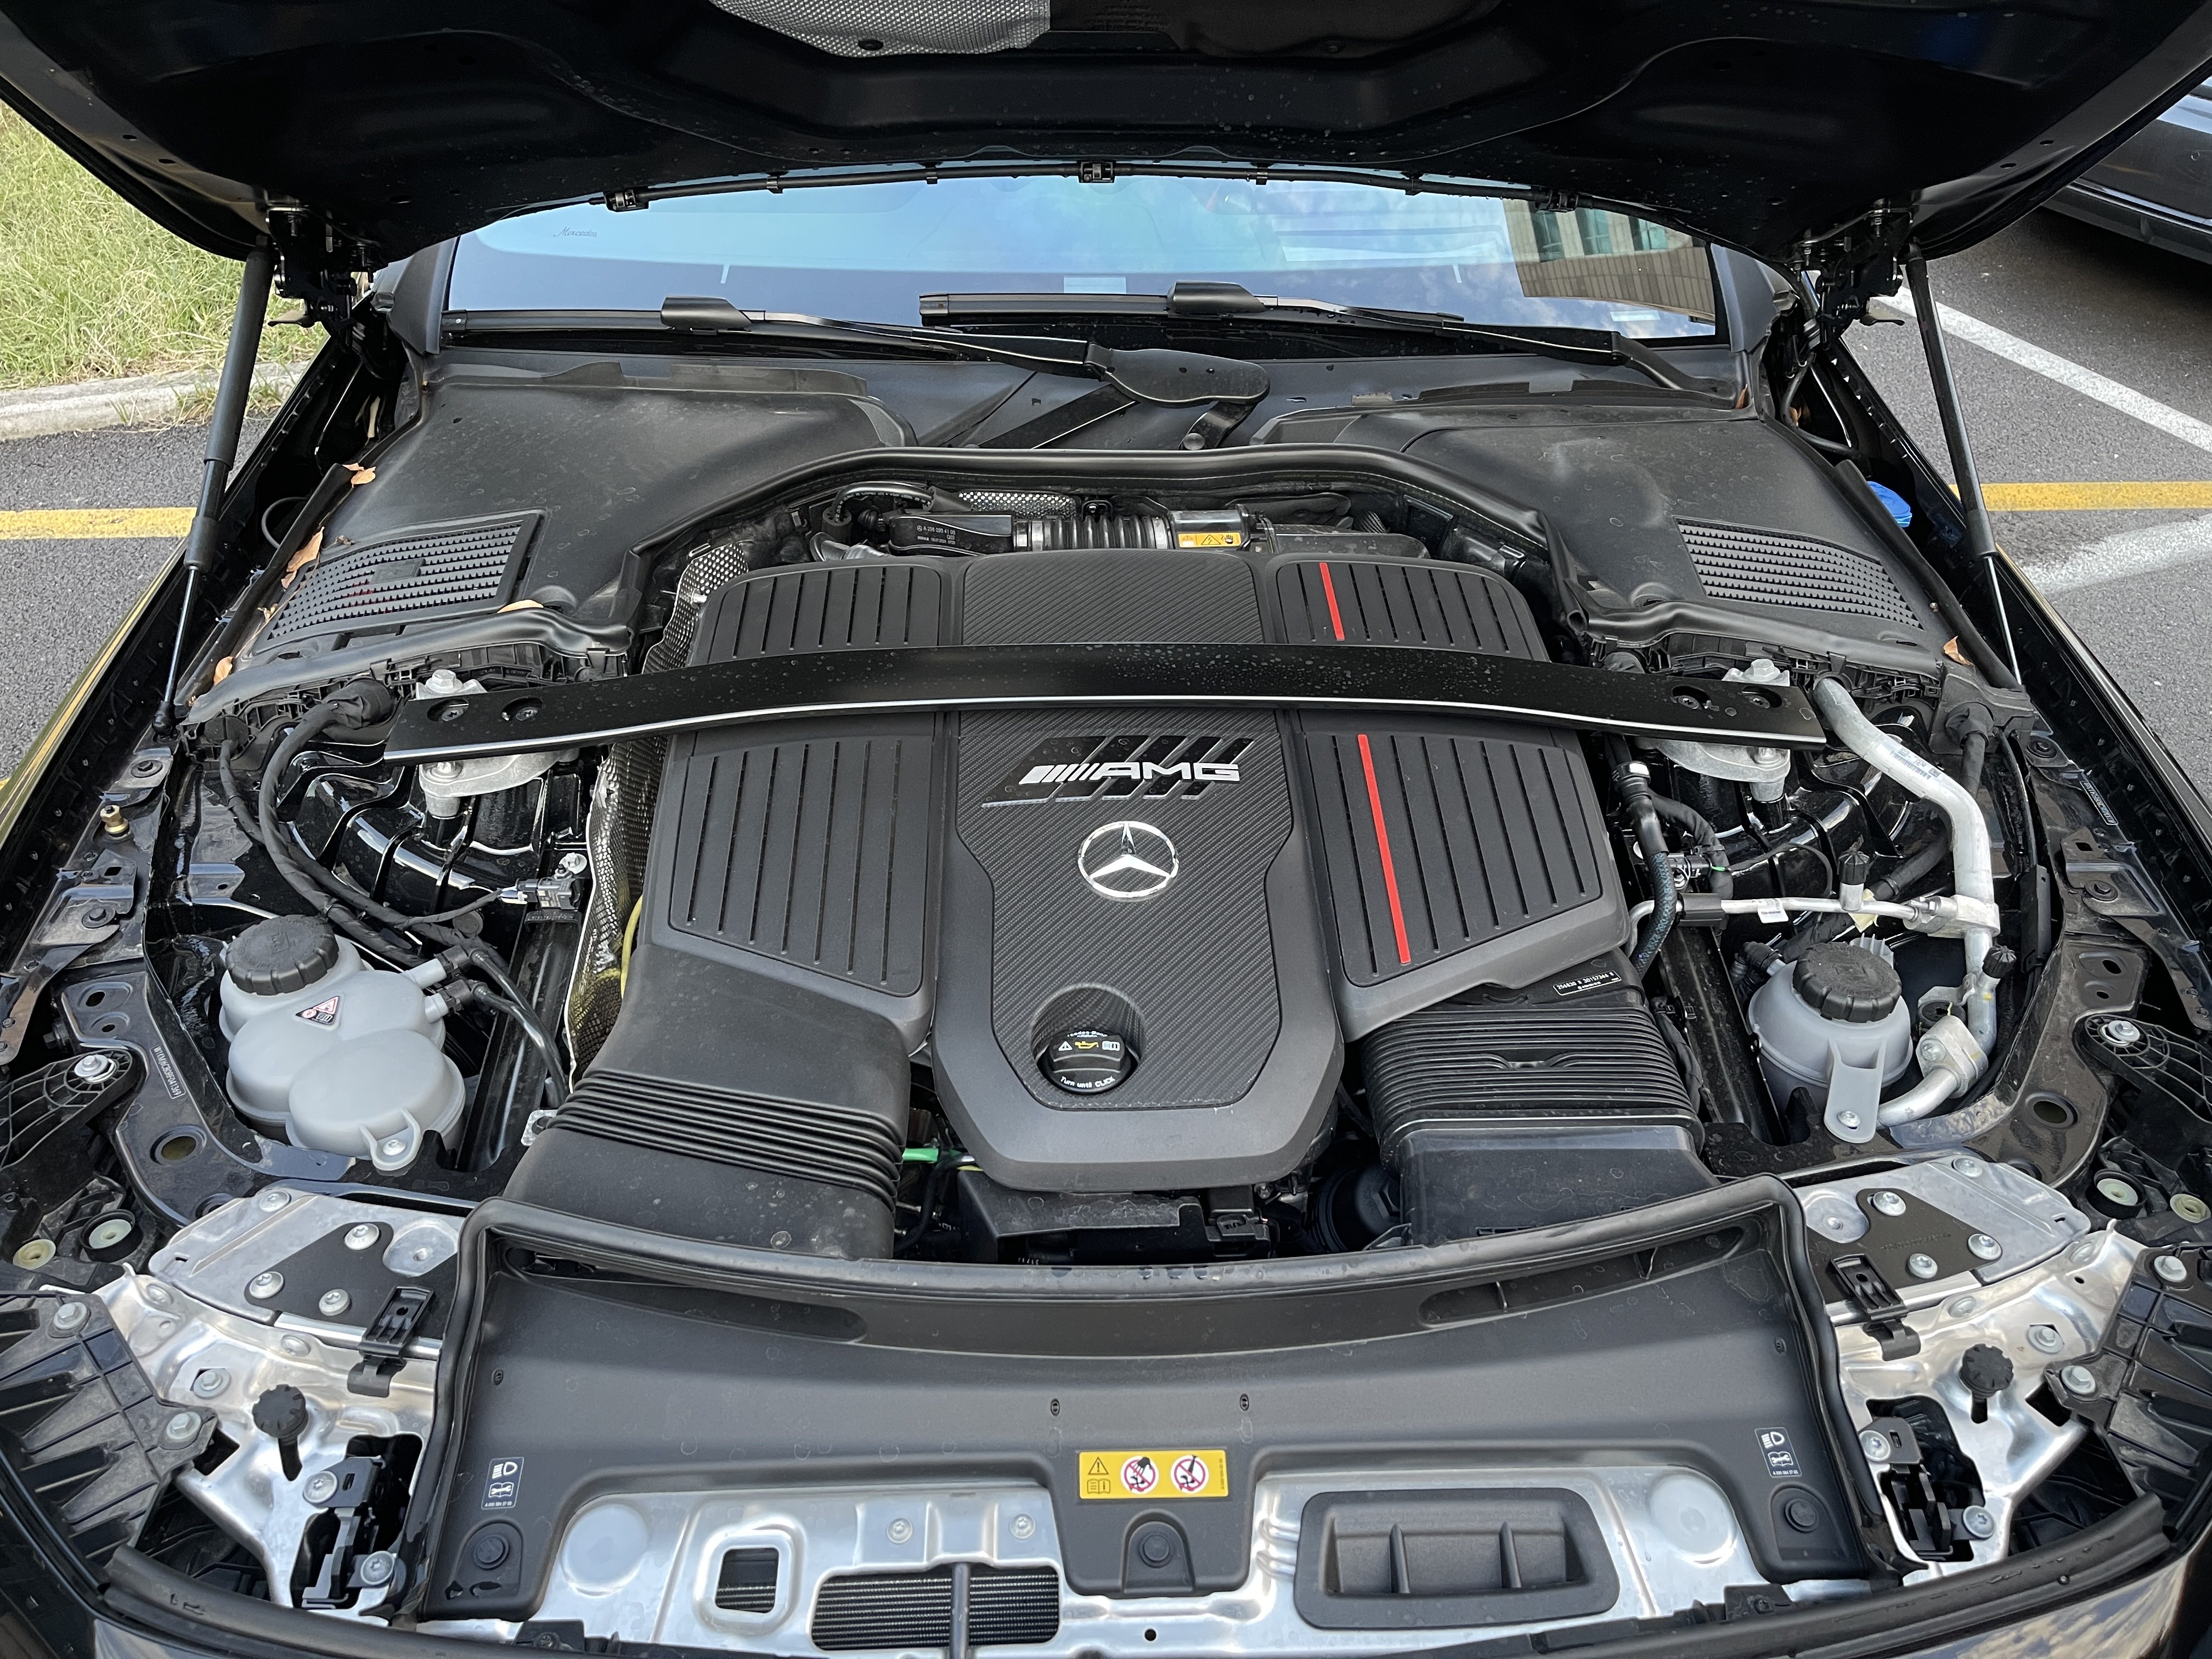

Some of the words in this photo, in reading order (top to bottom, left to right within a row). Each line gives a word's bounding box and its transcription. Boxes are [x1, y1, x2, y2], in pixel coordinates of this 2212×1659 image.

[553, 226, 597, 238] Mercedes
[1090, 761, 1240, 782] AMG
[1060, 1076, 1075, 1086] Turn
[1094, 1076, 1115, 1087] CLICK
